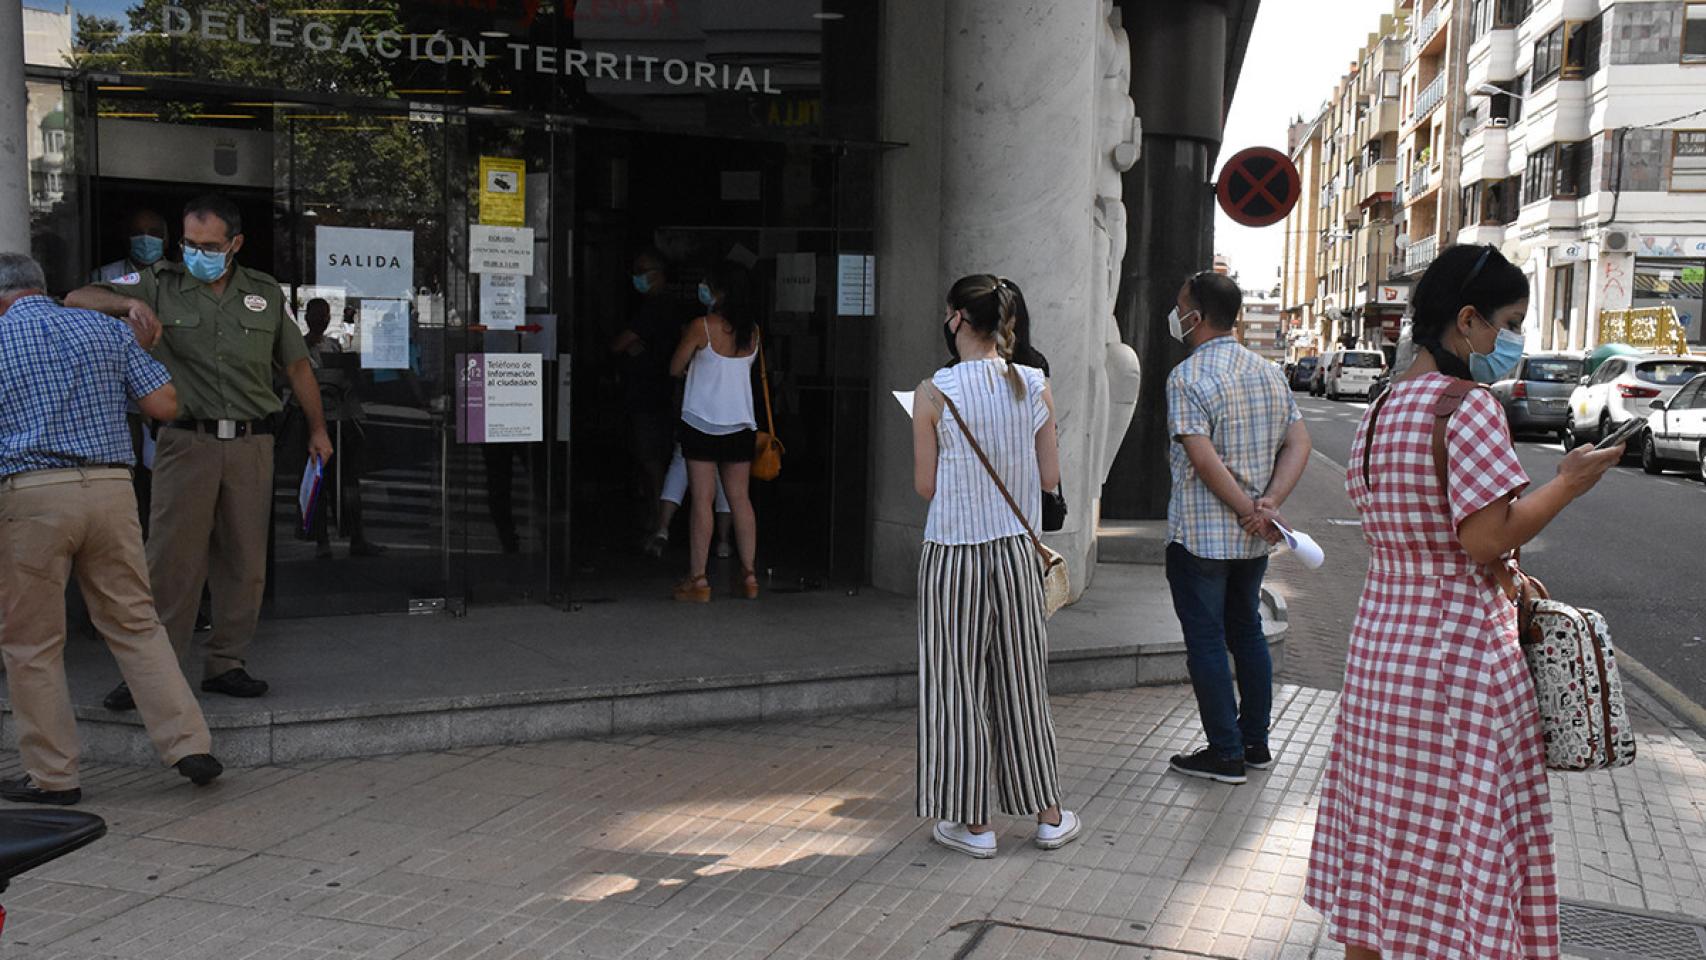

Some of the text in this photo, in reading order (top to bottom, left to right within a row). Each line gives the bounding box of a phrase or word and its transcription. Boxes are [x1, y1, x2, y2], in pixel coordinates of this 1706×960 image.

[161, 5, 782, 95] DELEGACIÓN TERRITORIAL
[328, 252, 402, 269] SALIDA
[487, 360, 532, 369] Teléfono de
[487, 369, 535, 378] información
[487, 378, 495, 387] al
[497, 378, 538, 387] ciudadano
